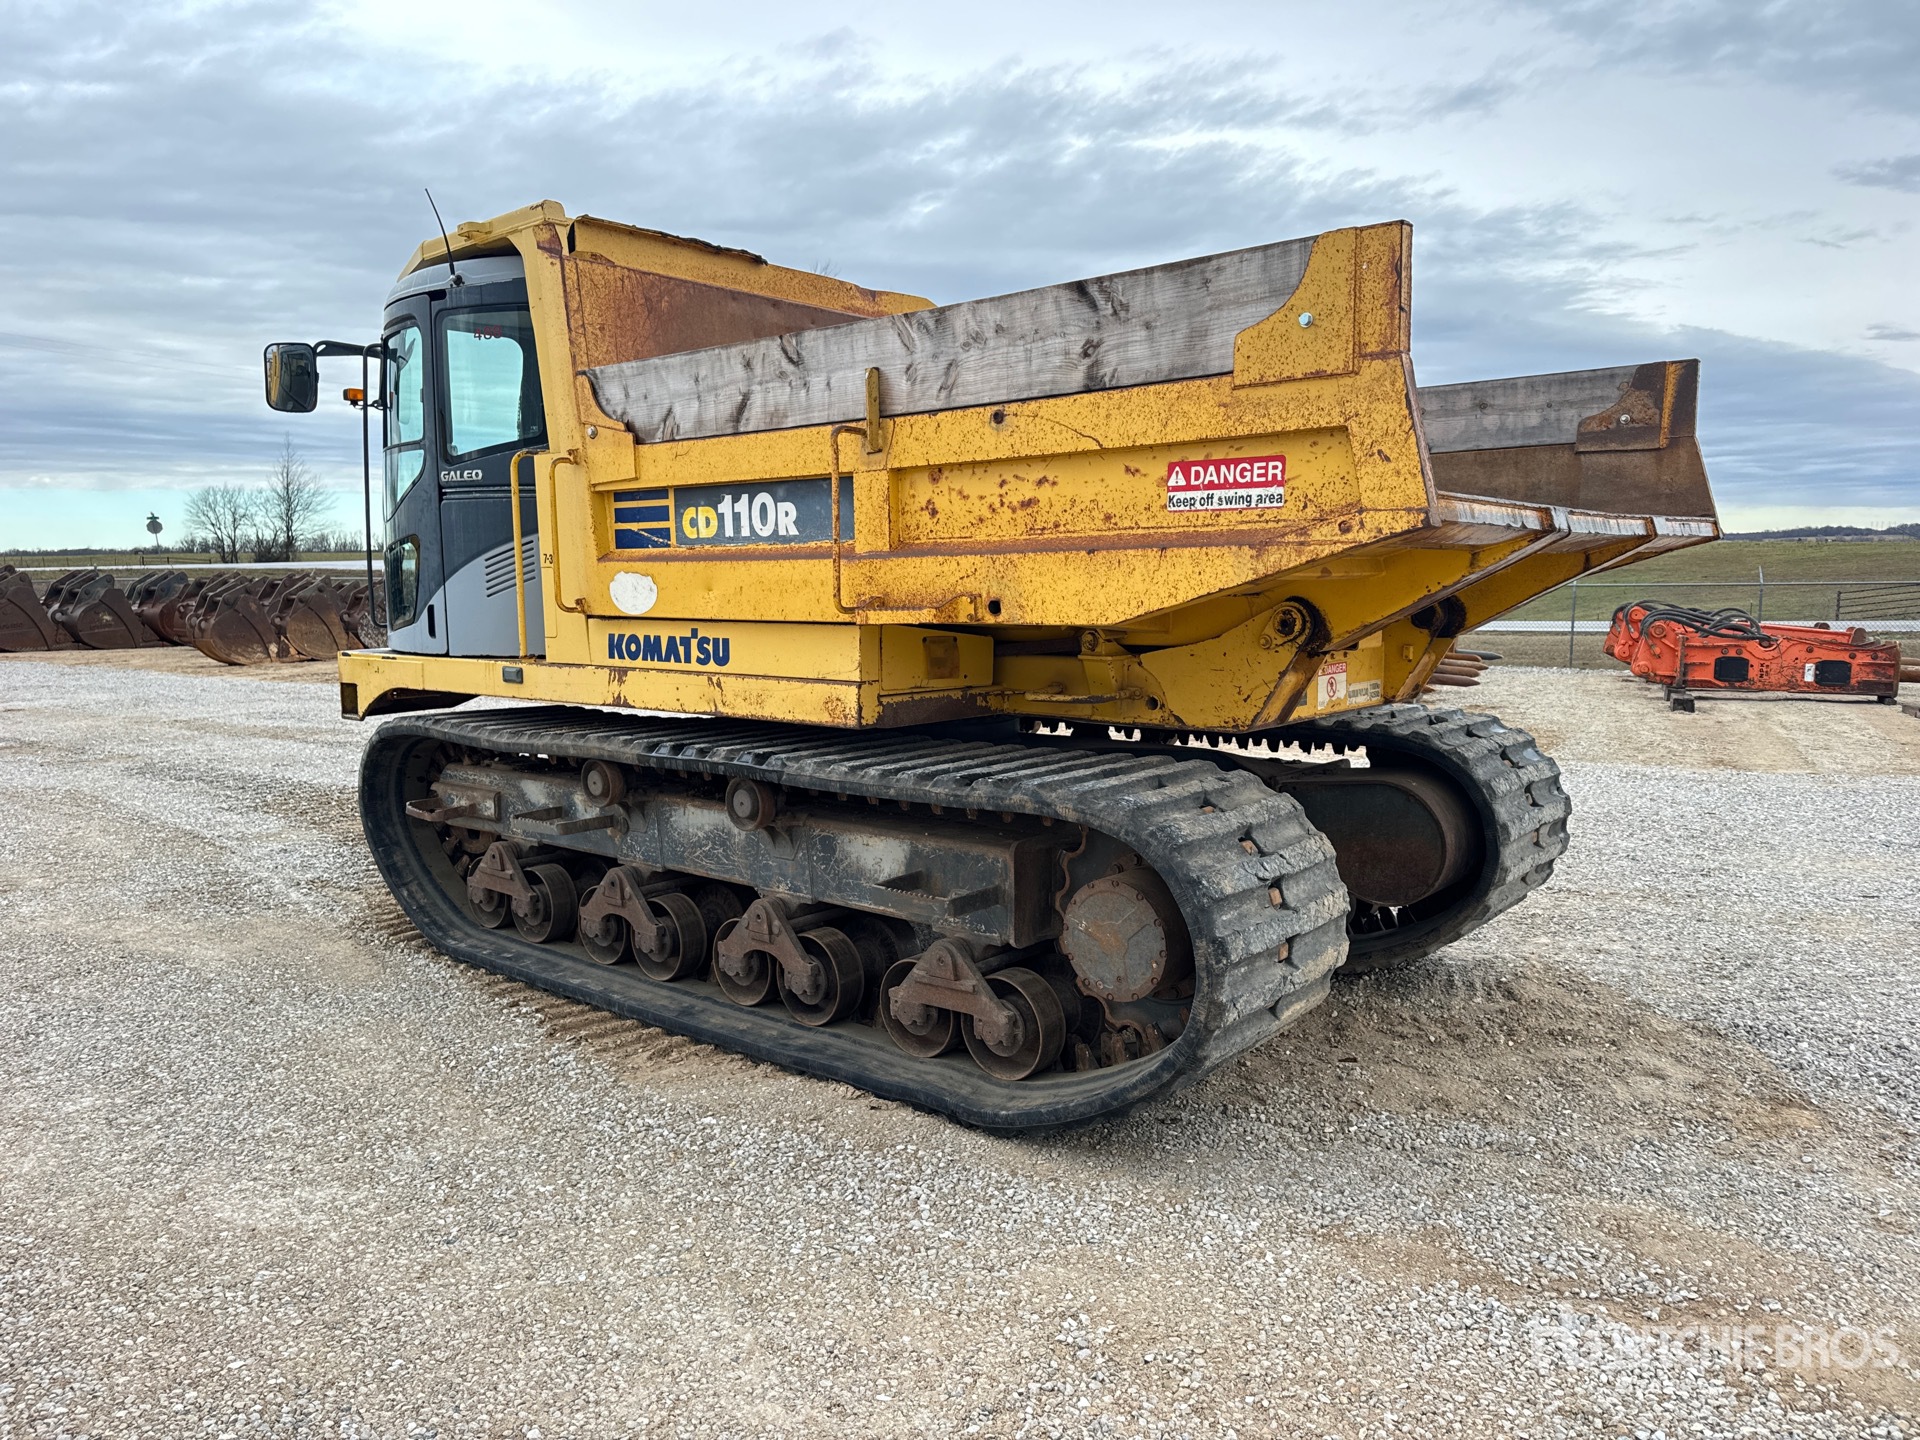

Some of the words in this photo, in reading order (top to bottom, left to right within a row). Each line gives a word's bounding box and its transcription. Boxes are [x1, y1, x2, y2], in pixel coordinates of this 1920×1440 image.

[441, 469, 483, 482] GALEO
[1190, 461, 1283, 486] DANGER
[1168, 494, 1196, 509] Keep
[1199, 493, 1214, 507] off
[1217, 491, 1253, 507] swing
[1257, 493, 1283, 506] area
[682, 492, 799, 539] CD110R
[543, 553, 553, 565] 7-3
[608, 628, 730, 667] KOMATSU
